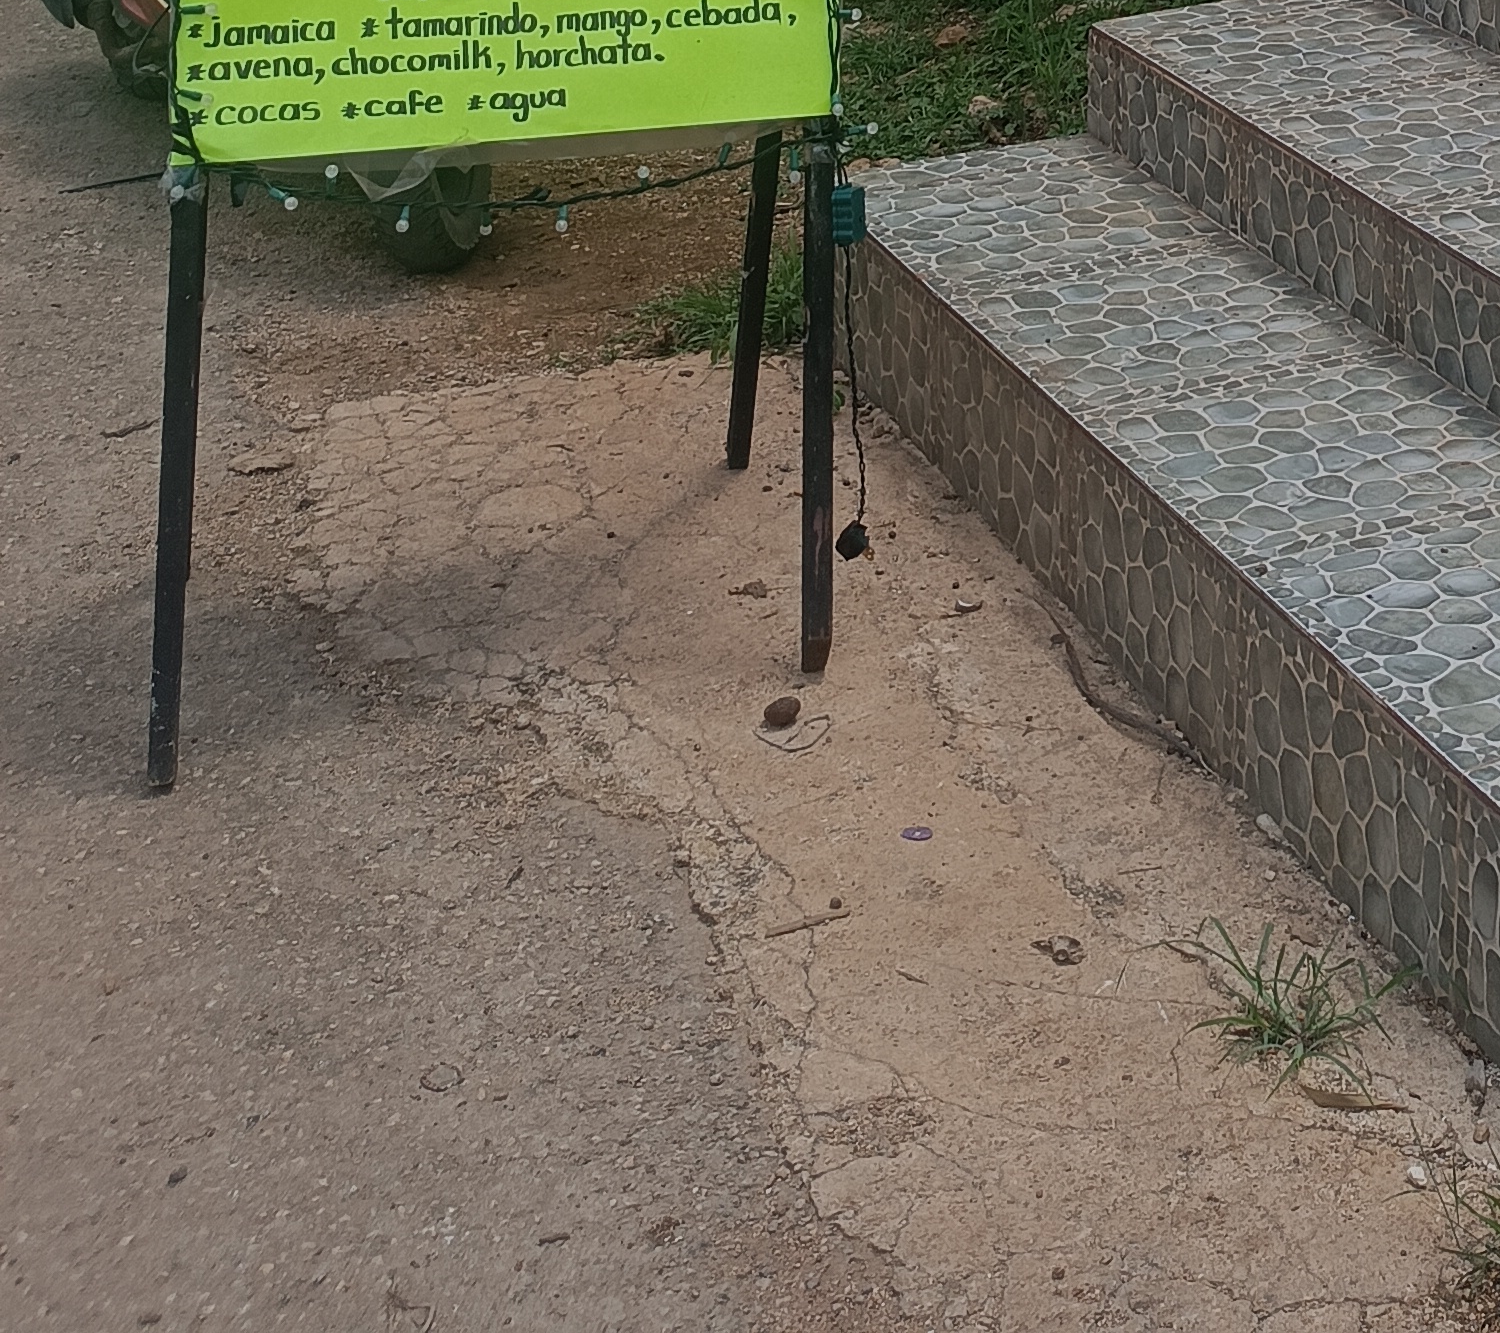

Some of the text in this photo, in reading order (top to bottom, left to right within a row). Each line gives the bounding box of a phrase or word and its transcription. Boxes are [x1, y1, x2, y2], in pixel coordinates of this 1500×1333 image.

[204, 16, 335, 47] jamaica
[385, 2, 549, 39] tamarindo,
[556, 10, 661, 36] mango,
[208, 57, 325, 84] avena,
[516, 35, 664, 69] horchata.
[215, 89, 566, 125] cocas cafe agua
